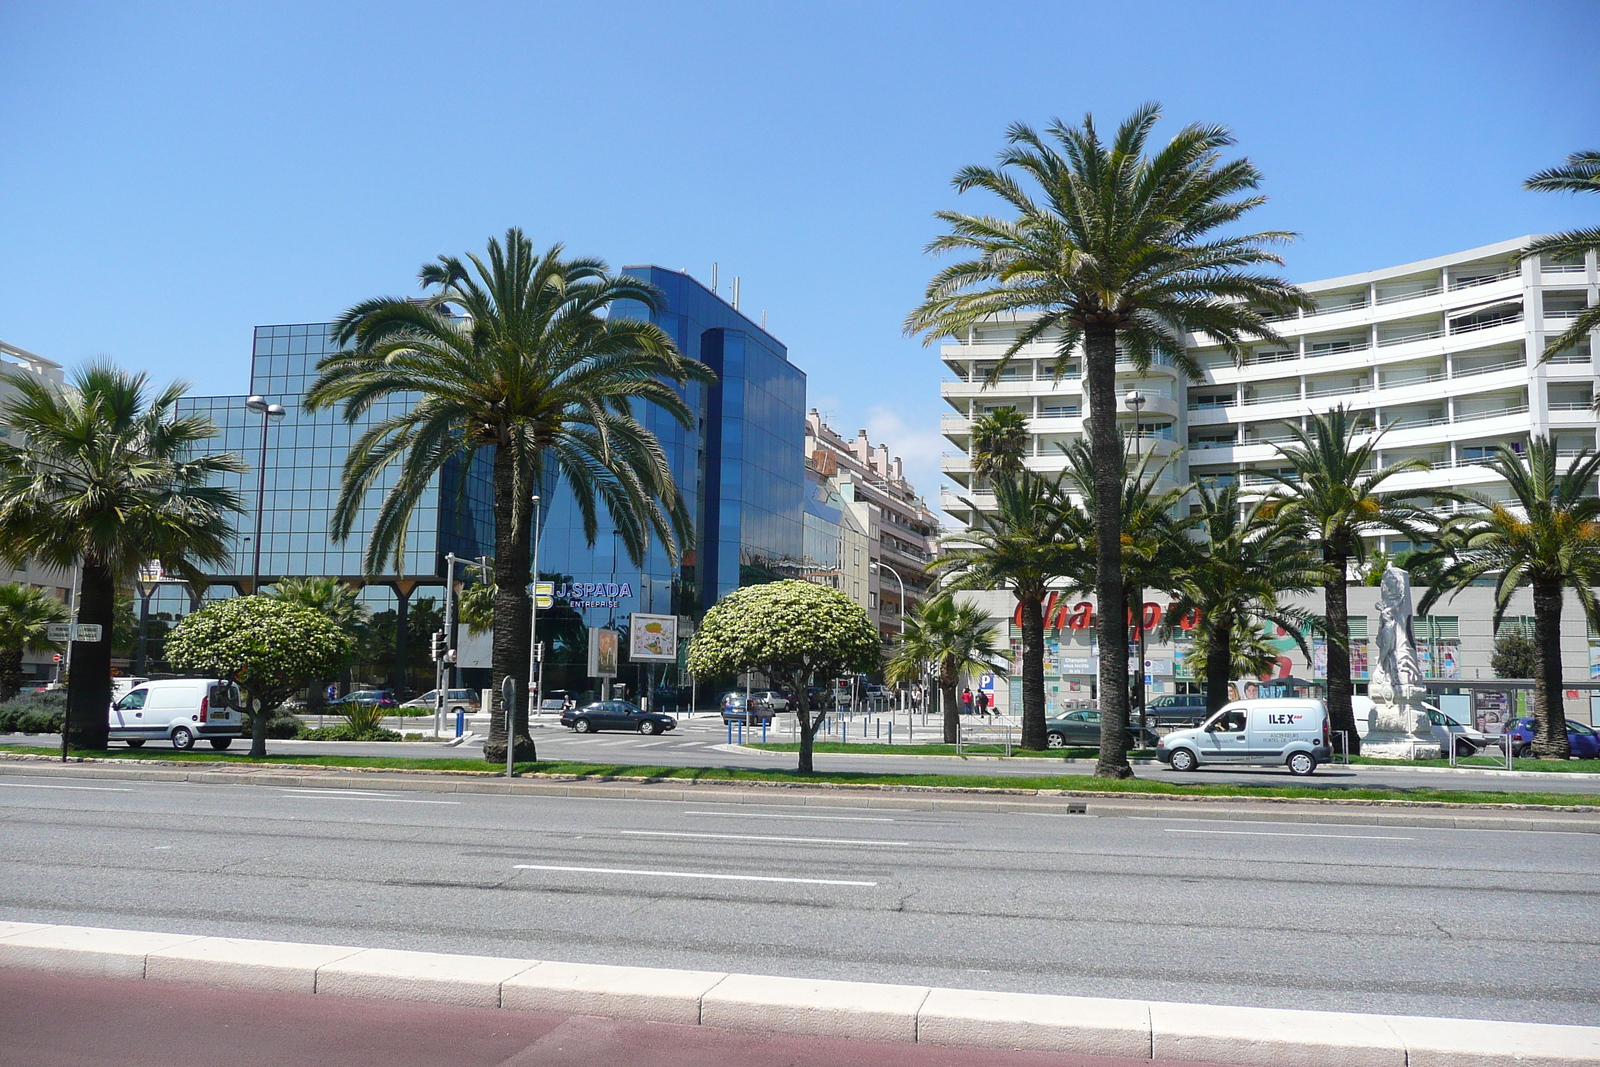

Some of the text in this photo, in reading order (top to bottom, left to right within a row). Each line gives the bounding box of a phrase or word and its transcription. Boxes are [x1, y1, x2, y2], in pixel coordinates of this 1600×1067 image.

[556, 582, 632, 598] J.SPADA
[570, 600, 619, 608] ENTREPRISE
[981, 675, 991, 688] P
[1268, 714, 1294, 725] ILEX
